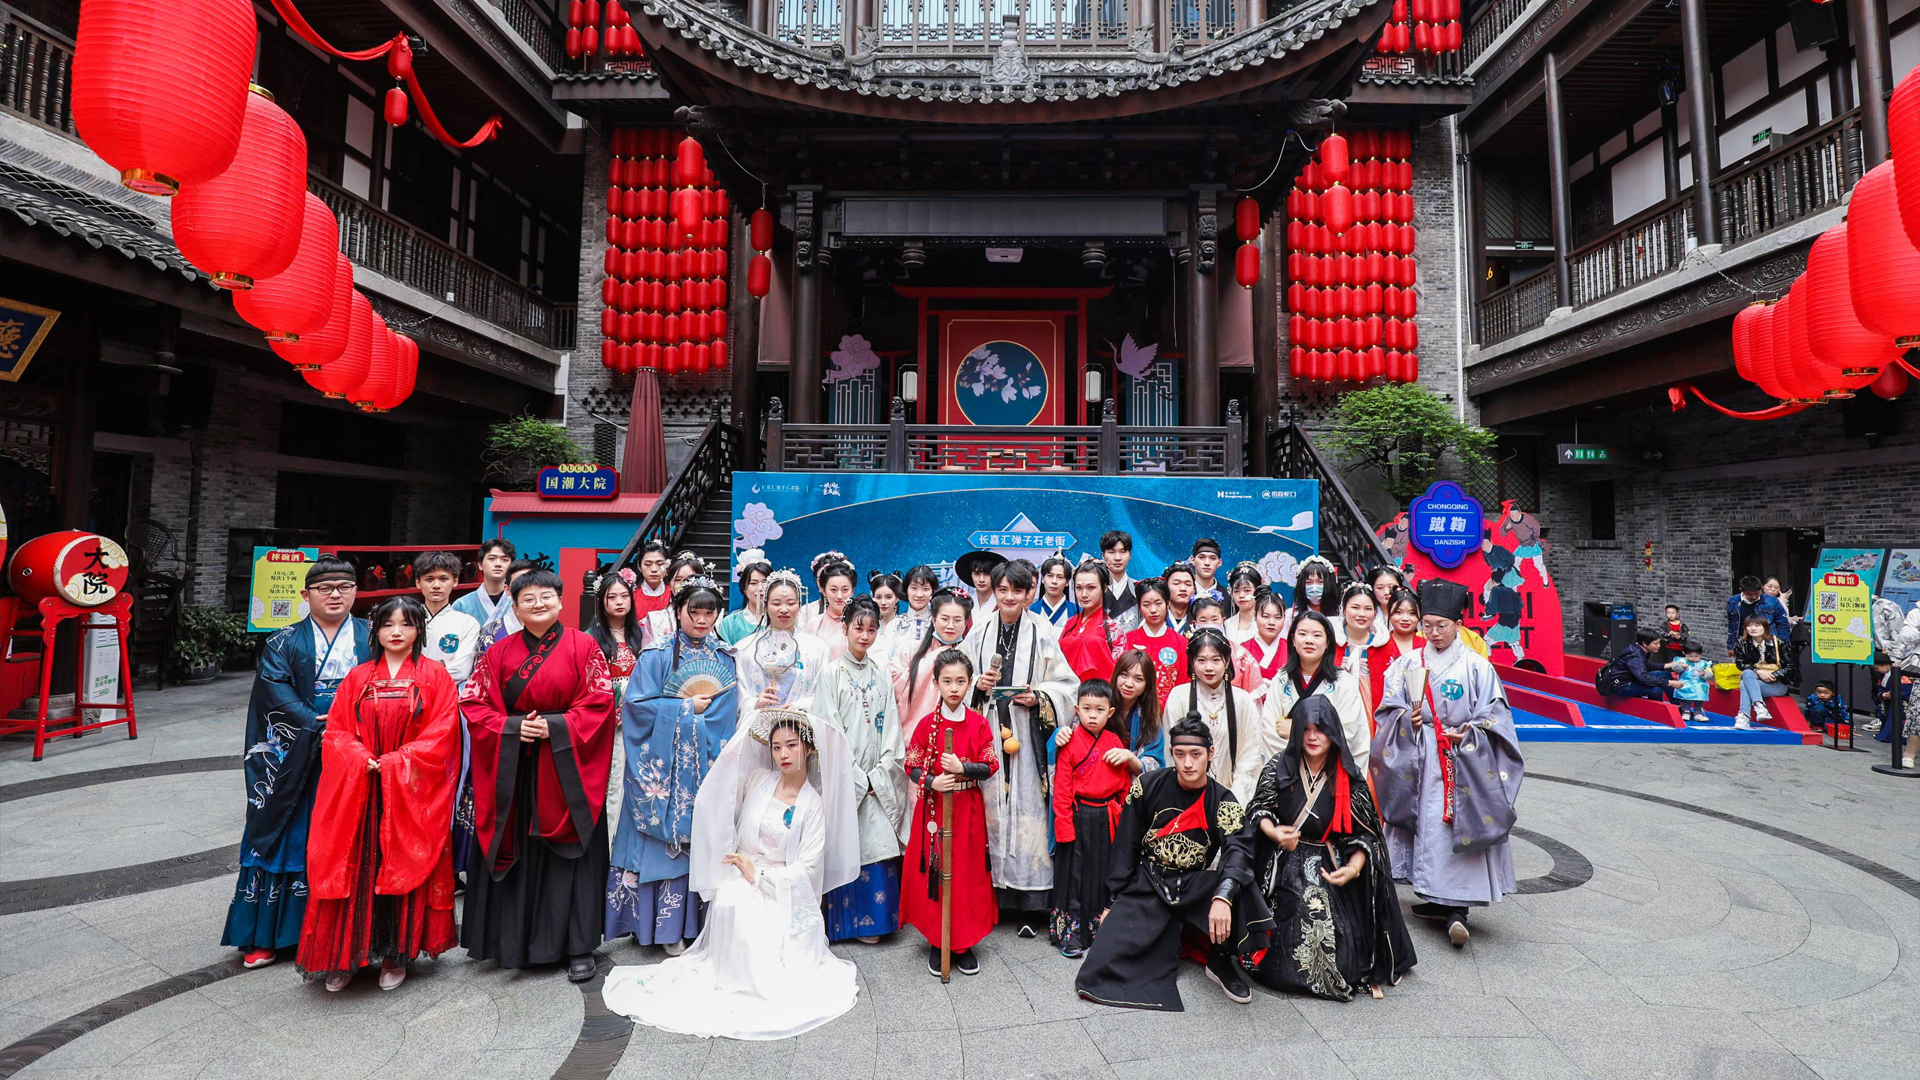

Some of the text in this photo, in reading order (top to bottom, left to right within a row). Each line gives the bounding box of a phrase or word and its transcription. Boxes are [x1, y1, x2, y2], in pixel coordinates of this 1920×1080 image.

[560, 464, 596, 473] LUCKY
[545, 476, 607, 490] 国潮大院
[1428, 516, 1467, 533] 蹴鞠
[979, 534, 1066, 547] 长嘉汇弹子石老街
[82, 546, 110, 596] 大院
[443, 639, 456, 647] 34
[1163, 651, 1173, 660] 11
[1446, 685, 1458, 693] 17
